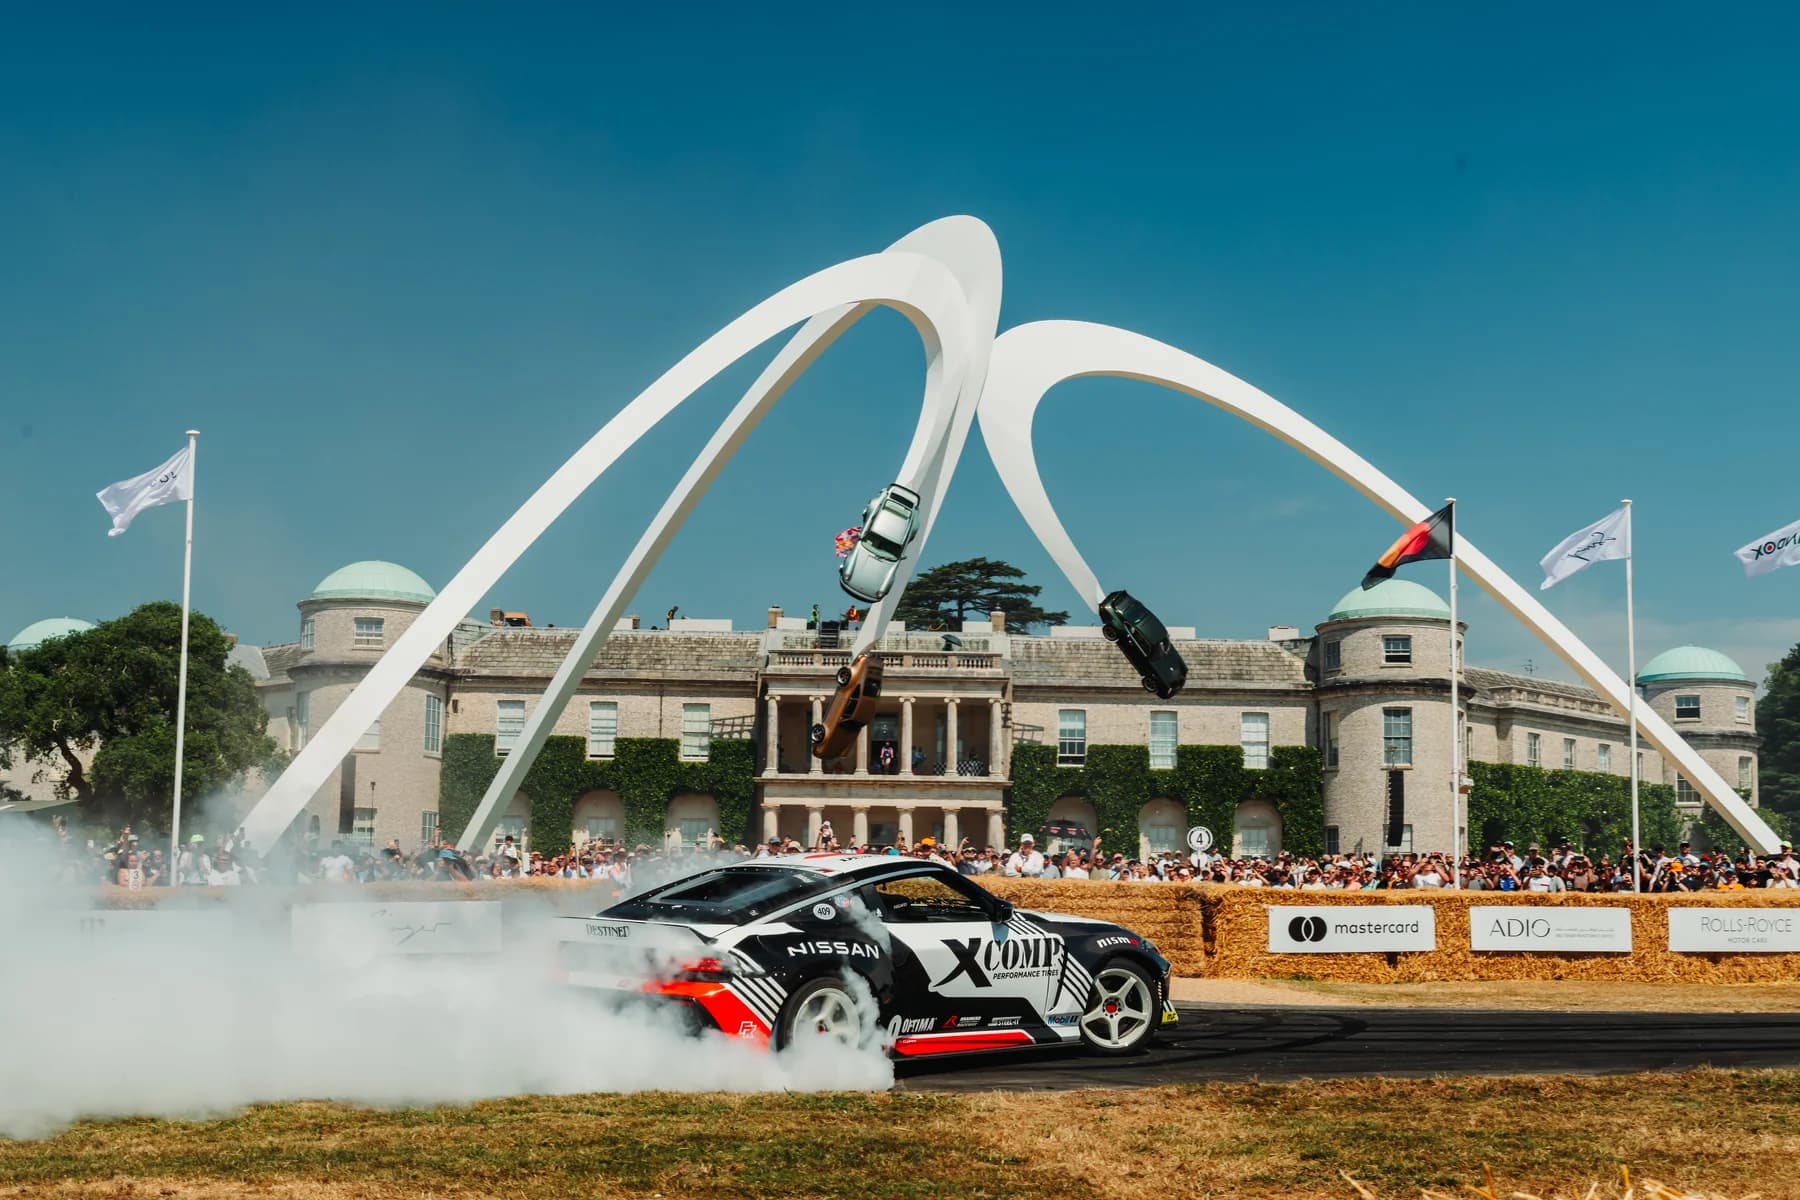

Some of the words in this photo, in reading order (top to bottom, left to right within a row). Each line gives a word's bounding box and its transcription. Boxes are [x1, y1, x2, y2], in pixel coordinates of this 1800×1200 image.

[1196, 832, 1203, 845] 4
[817, 907, 831, 916] 409
[585, 923, 630, 938] DESTINED
[1334, 921, 1419, 934] mastercard
[1489, 918, 1551, 938] ADIO
[1701, 916, 1792, 933] ROLLS-ROYCE
[787, 941, 880, 960] NISSAN
[992, 970, 1041, 980] PERFORMANCE
[902, 1017, 935, 1033] OPTIMA
